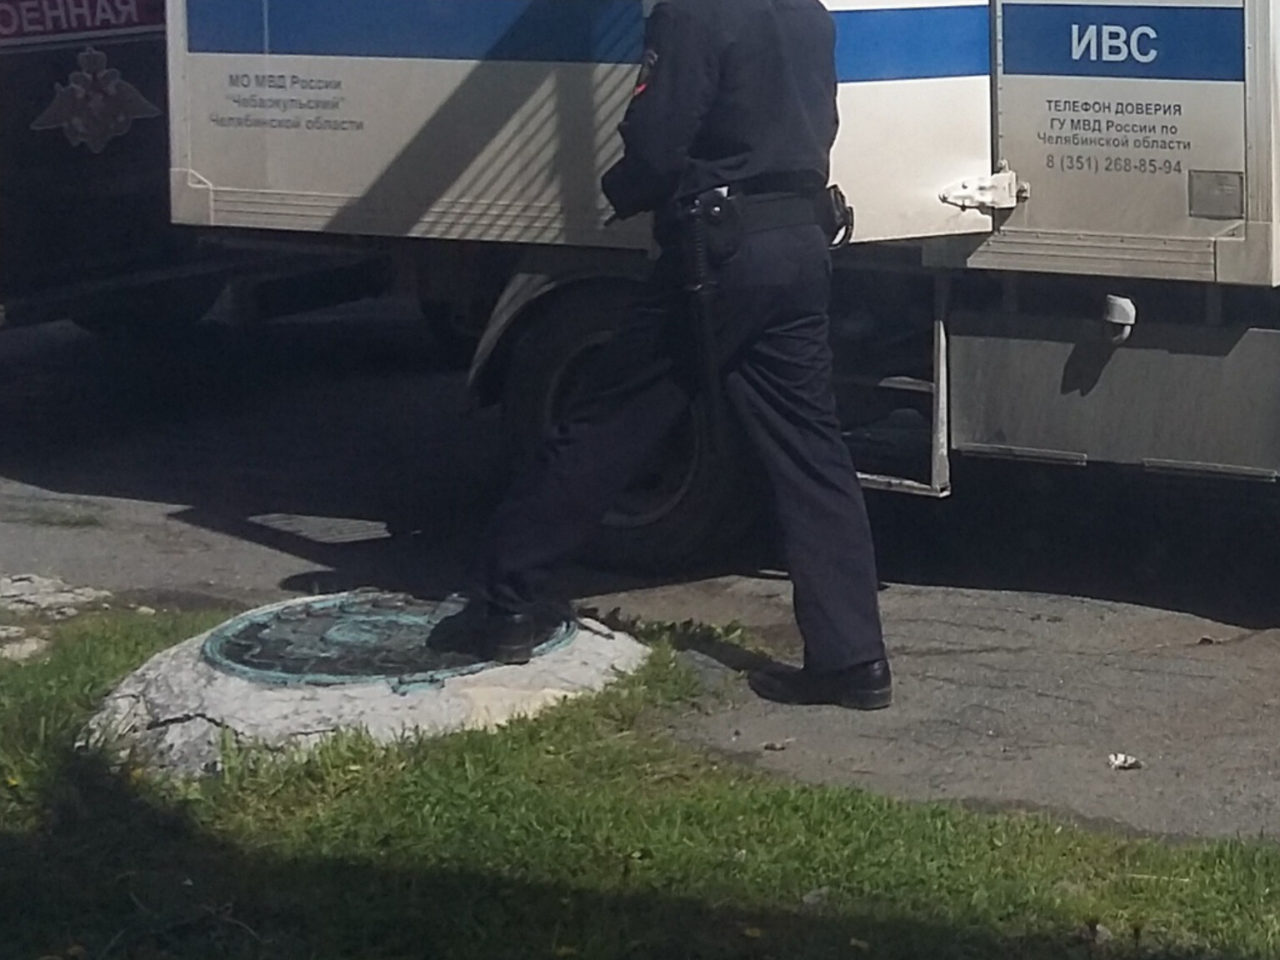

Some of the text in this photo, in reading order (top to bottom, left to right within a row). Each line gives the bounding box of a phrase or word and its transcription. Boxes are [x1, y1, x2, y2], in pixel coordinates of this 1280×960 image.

[1071, 24, 1157, 63] ИВС
[290, 75, 342, 90] России
[1046, 99, 1182, 116] ТЕЛЕФОН ДОВЕРИЯ
[305, 116, 364, 131] области
[1050, 118, 1178, 135] ГУ МВД России по
[1037, 132, 1191, 151] Челябинской области
[1046, 155, 1182, 174] 8 (351) 268-85-94
